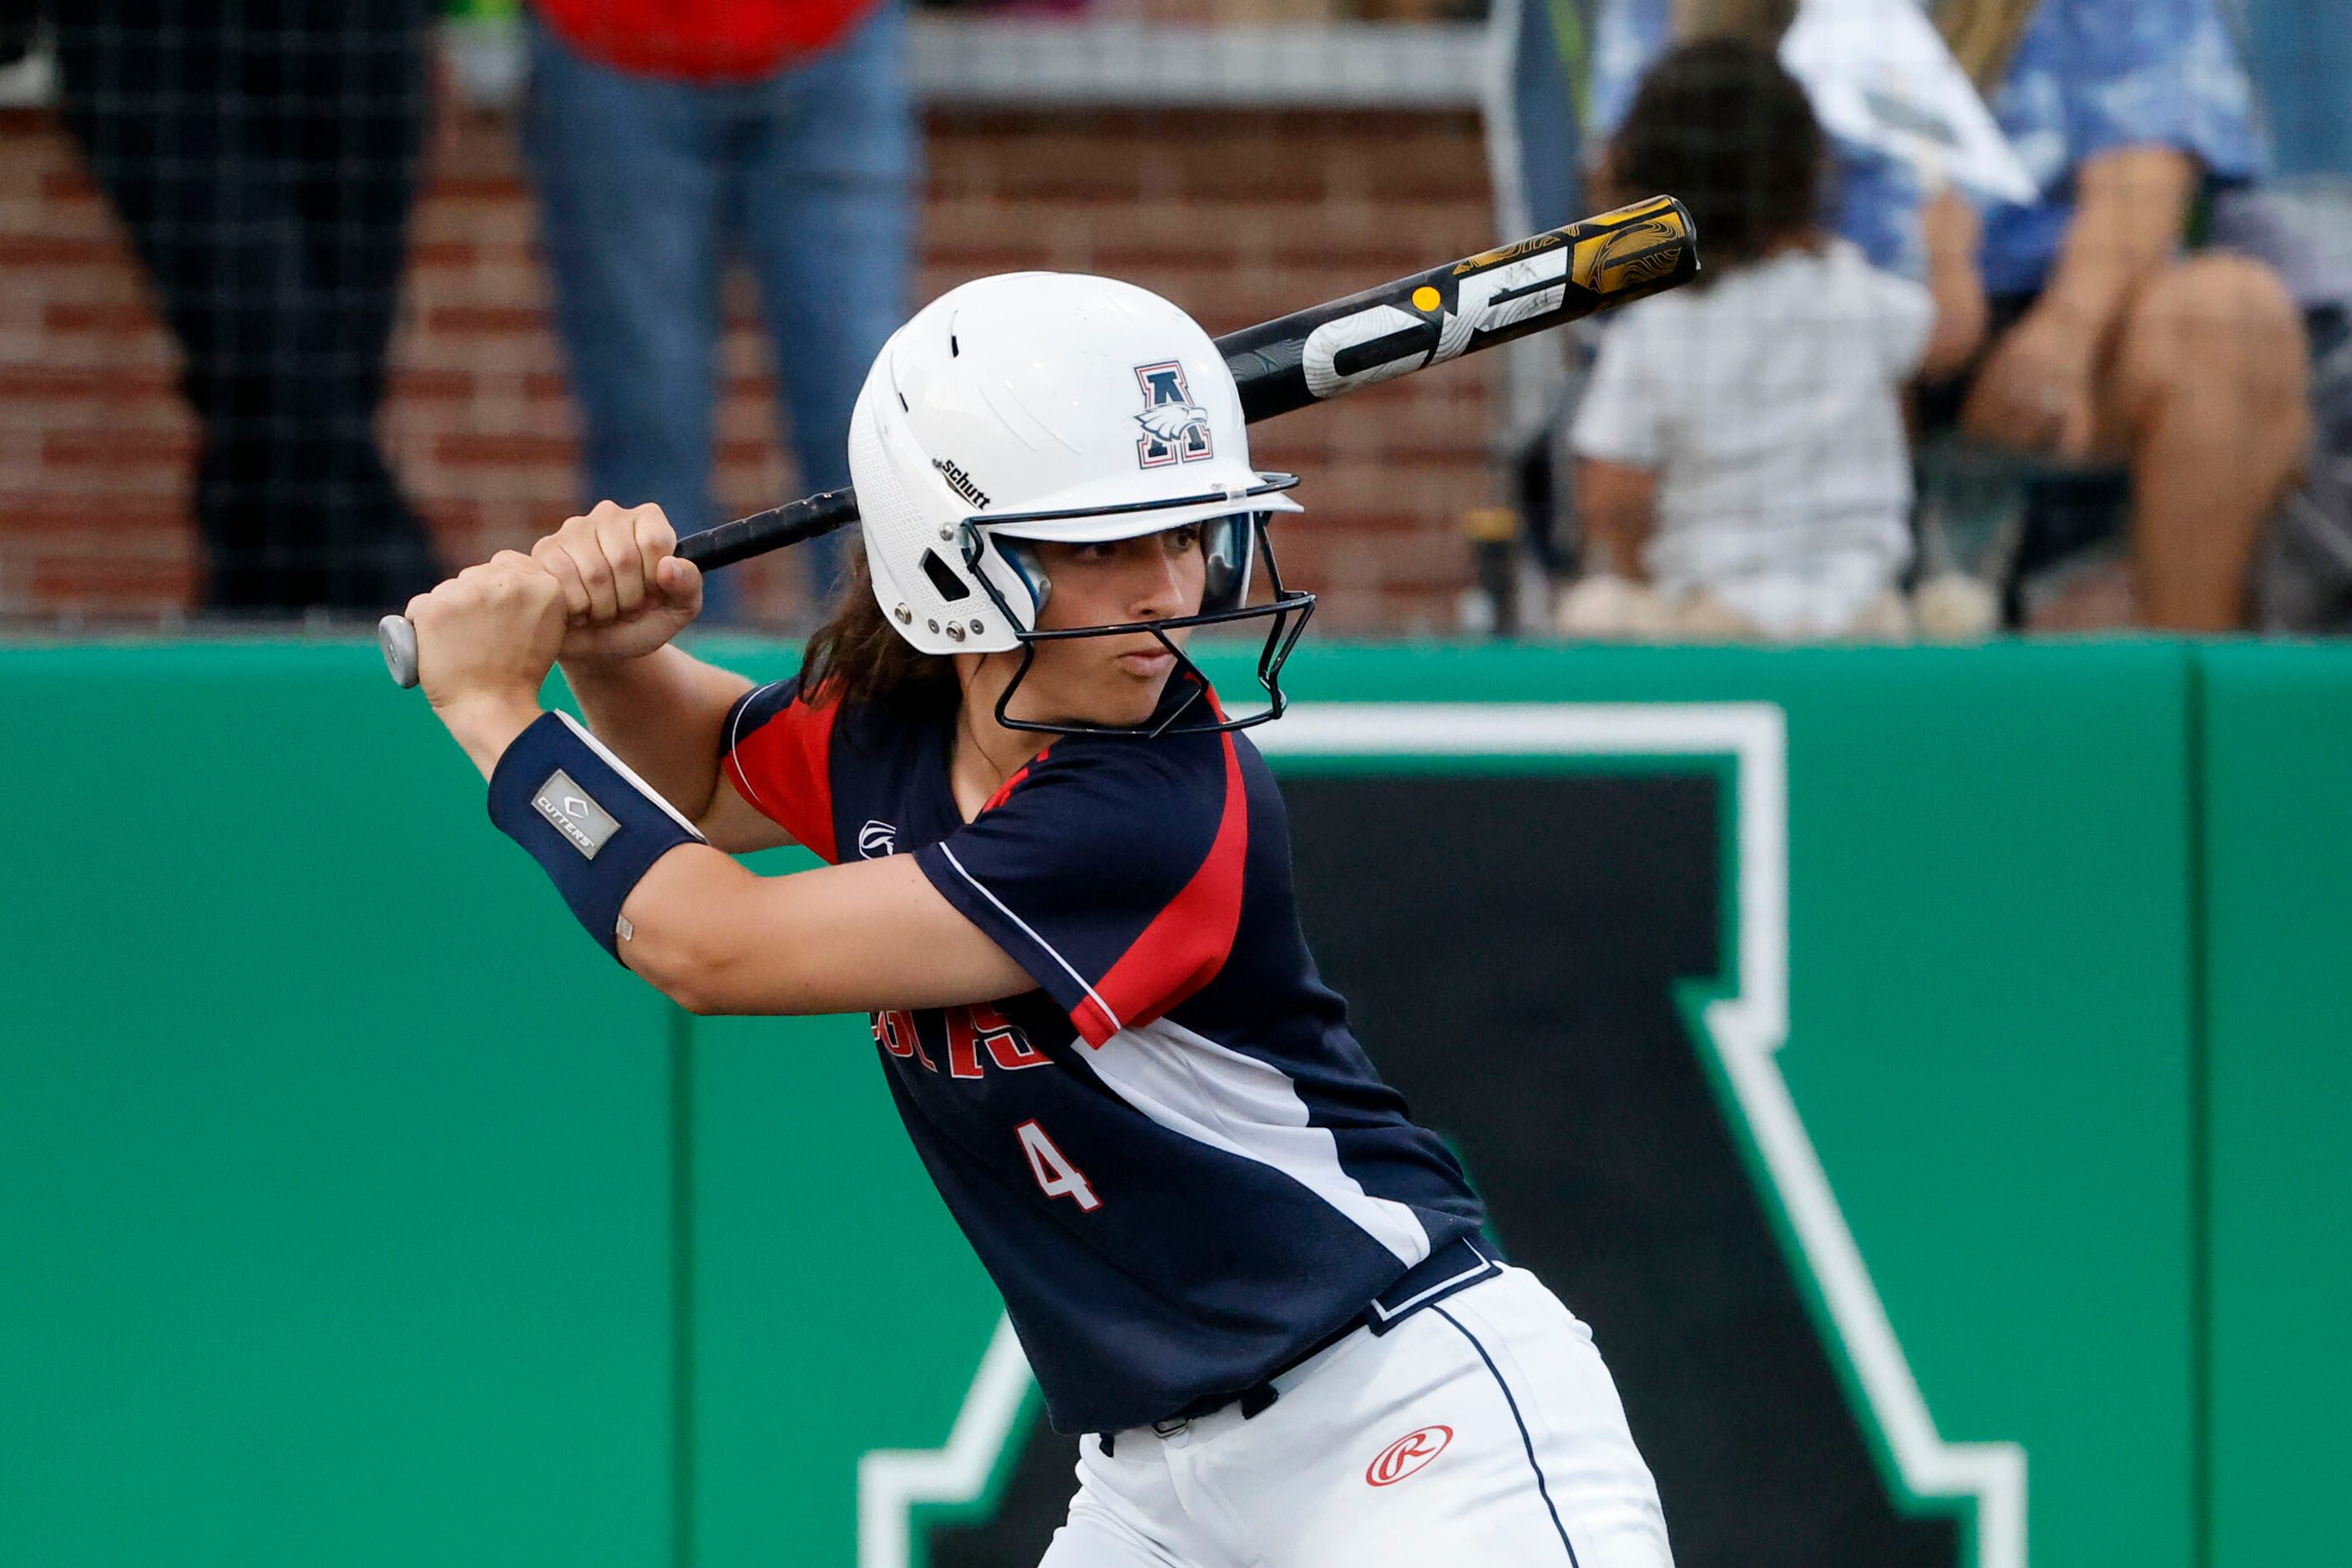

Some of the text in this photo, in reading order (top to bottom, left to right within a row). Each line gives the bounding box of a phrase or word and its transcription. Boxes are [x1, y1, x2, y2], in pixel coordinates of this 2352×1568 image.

[1133, 360, 1215, 470] A
[942, 458, 991, 510] schutt
[537, 796, 593, 848] CUTTERS
[1014, 1119, 1103, 1212] 4
